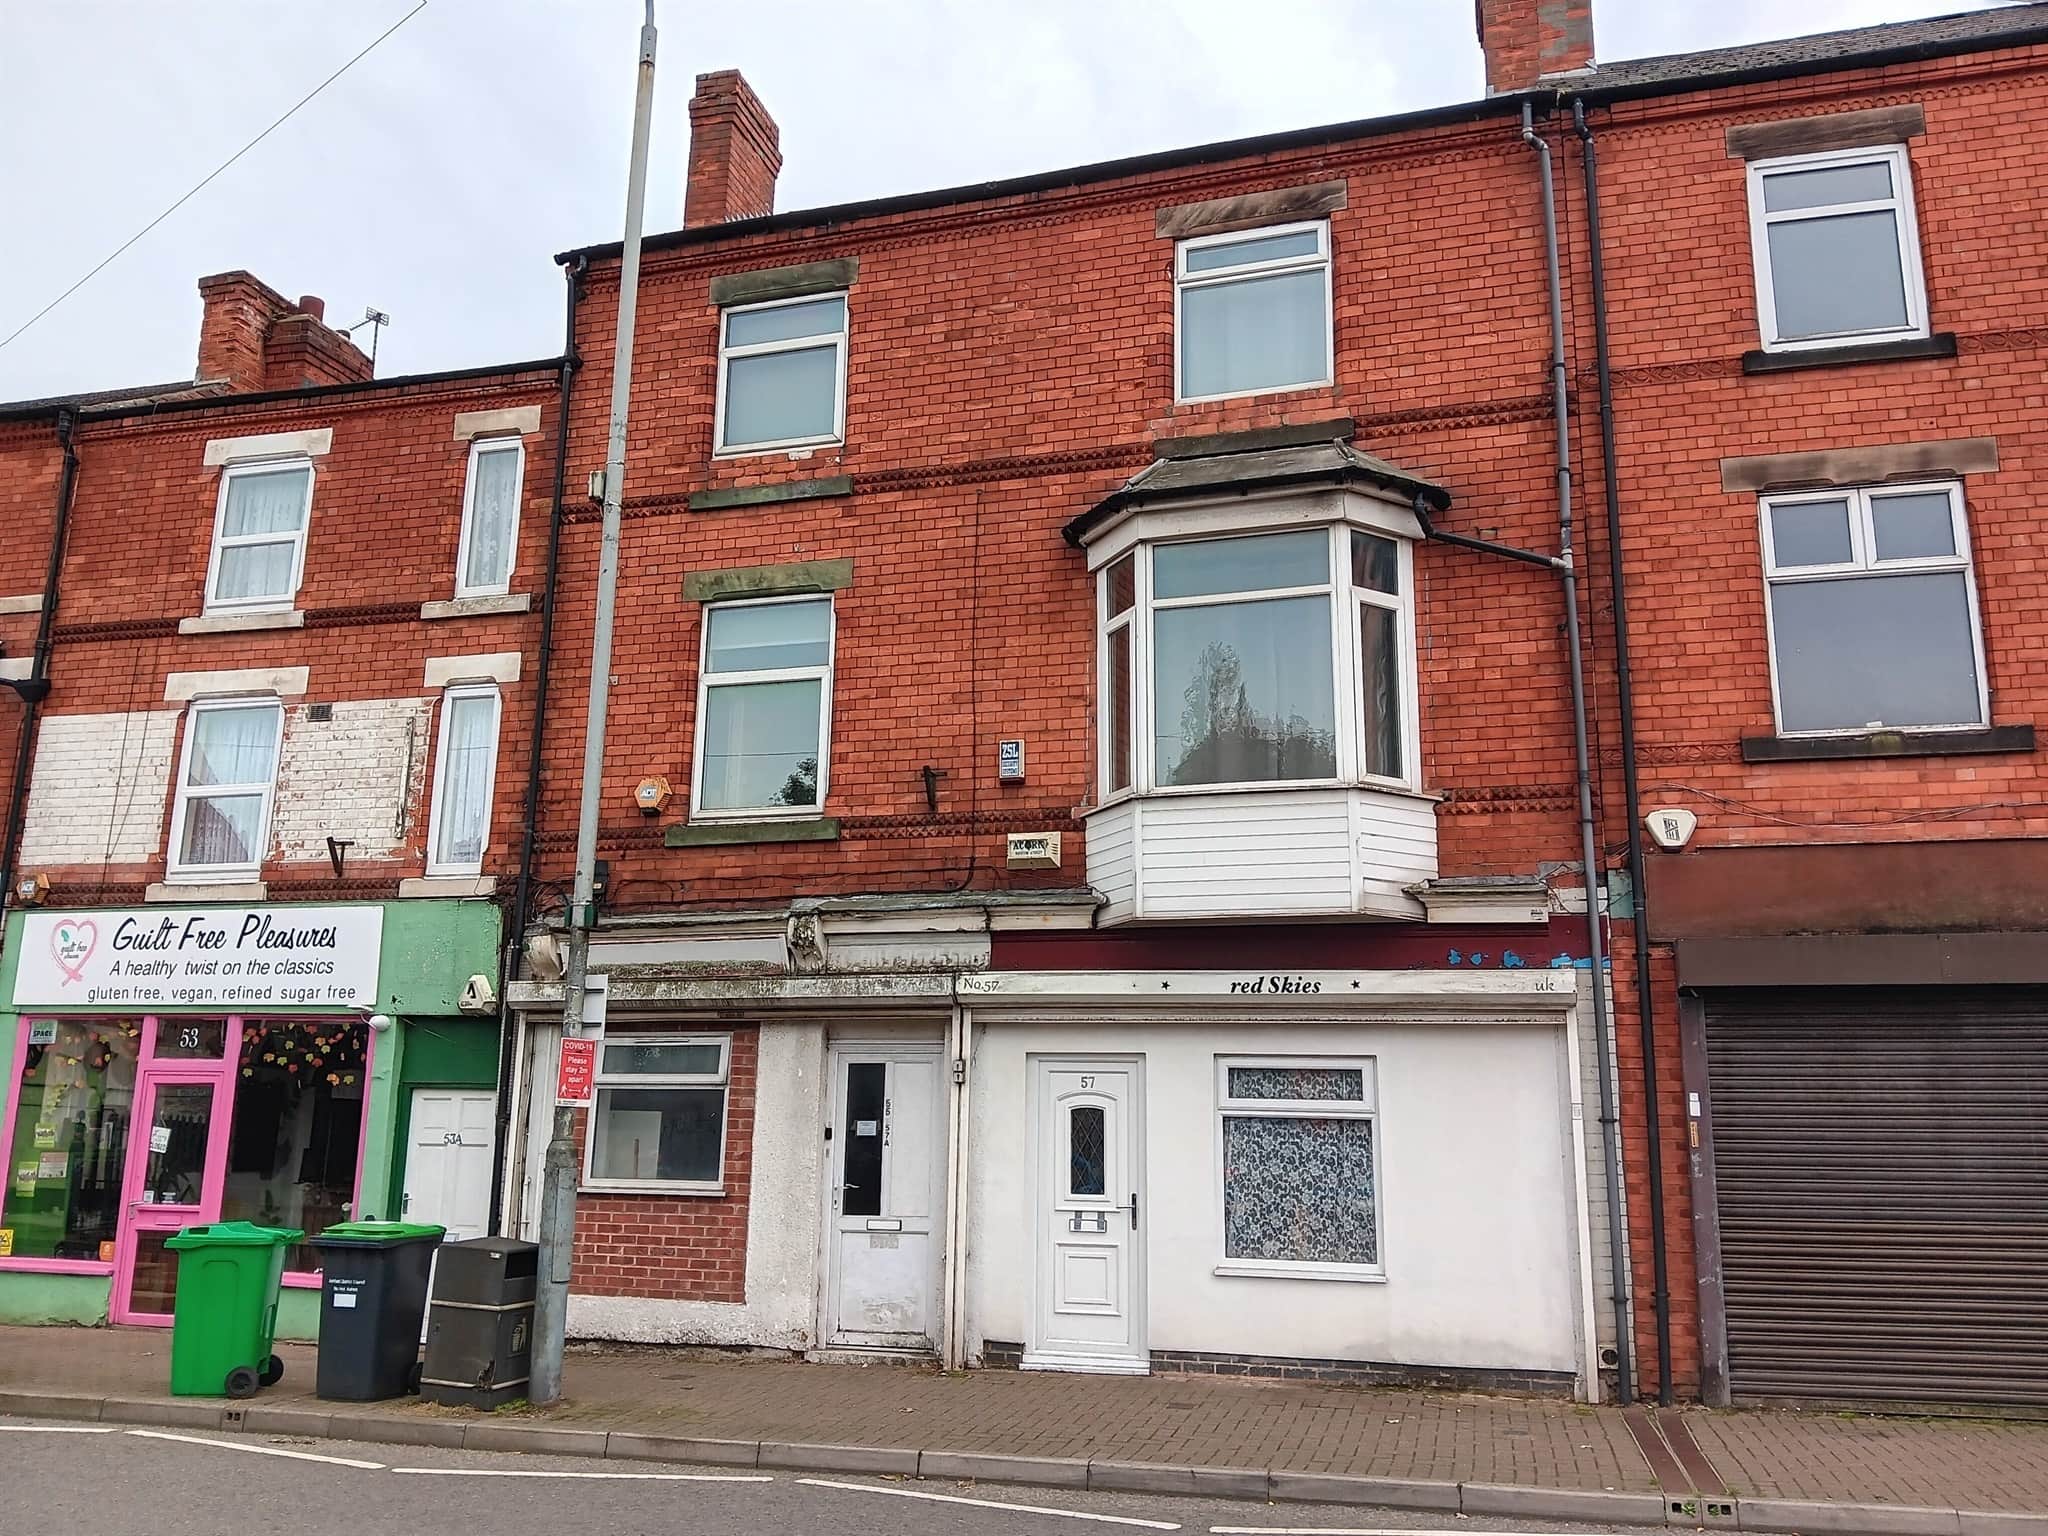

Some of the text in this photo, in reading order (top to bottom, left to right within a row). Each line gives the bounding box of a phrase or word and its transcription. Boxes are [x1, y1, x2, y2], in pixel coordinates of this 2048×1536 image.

[1002, 743, 1018, 758] ZSL
[113, 913, 337, 950] Guilt Free Pleasures
[109, 957, 335, 979] A healthy twist on the classics
[1230, 976, 1322, 994] red Skies
[1535, 976, 1555, 992] uk
[87, 984, 356, 1003] gluten free, vegan, refined sugar free
[179, 1027, 199, 1048] 53
[567, 1056, 587, 1065] Please
[565, 1067, 577, 1075] stay
[1081, 1076, 1095, 1088] 57
[443, 1133, 463, 1145] 53A
